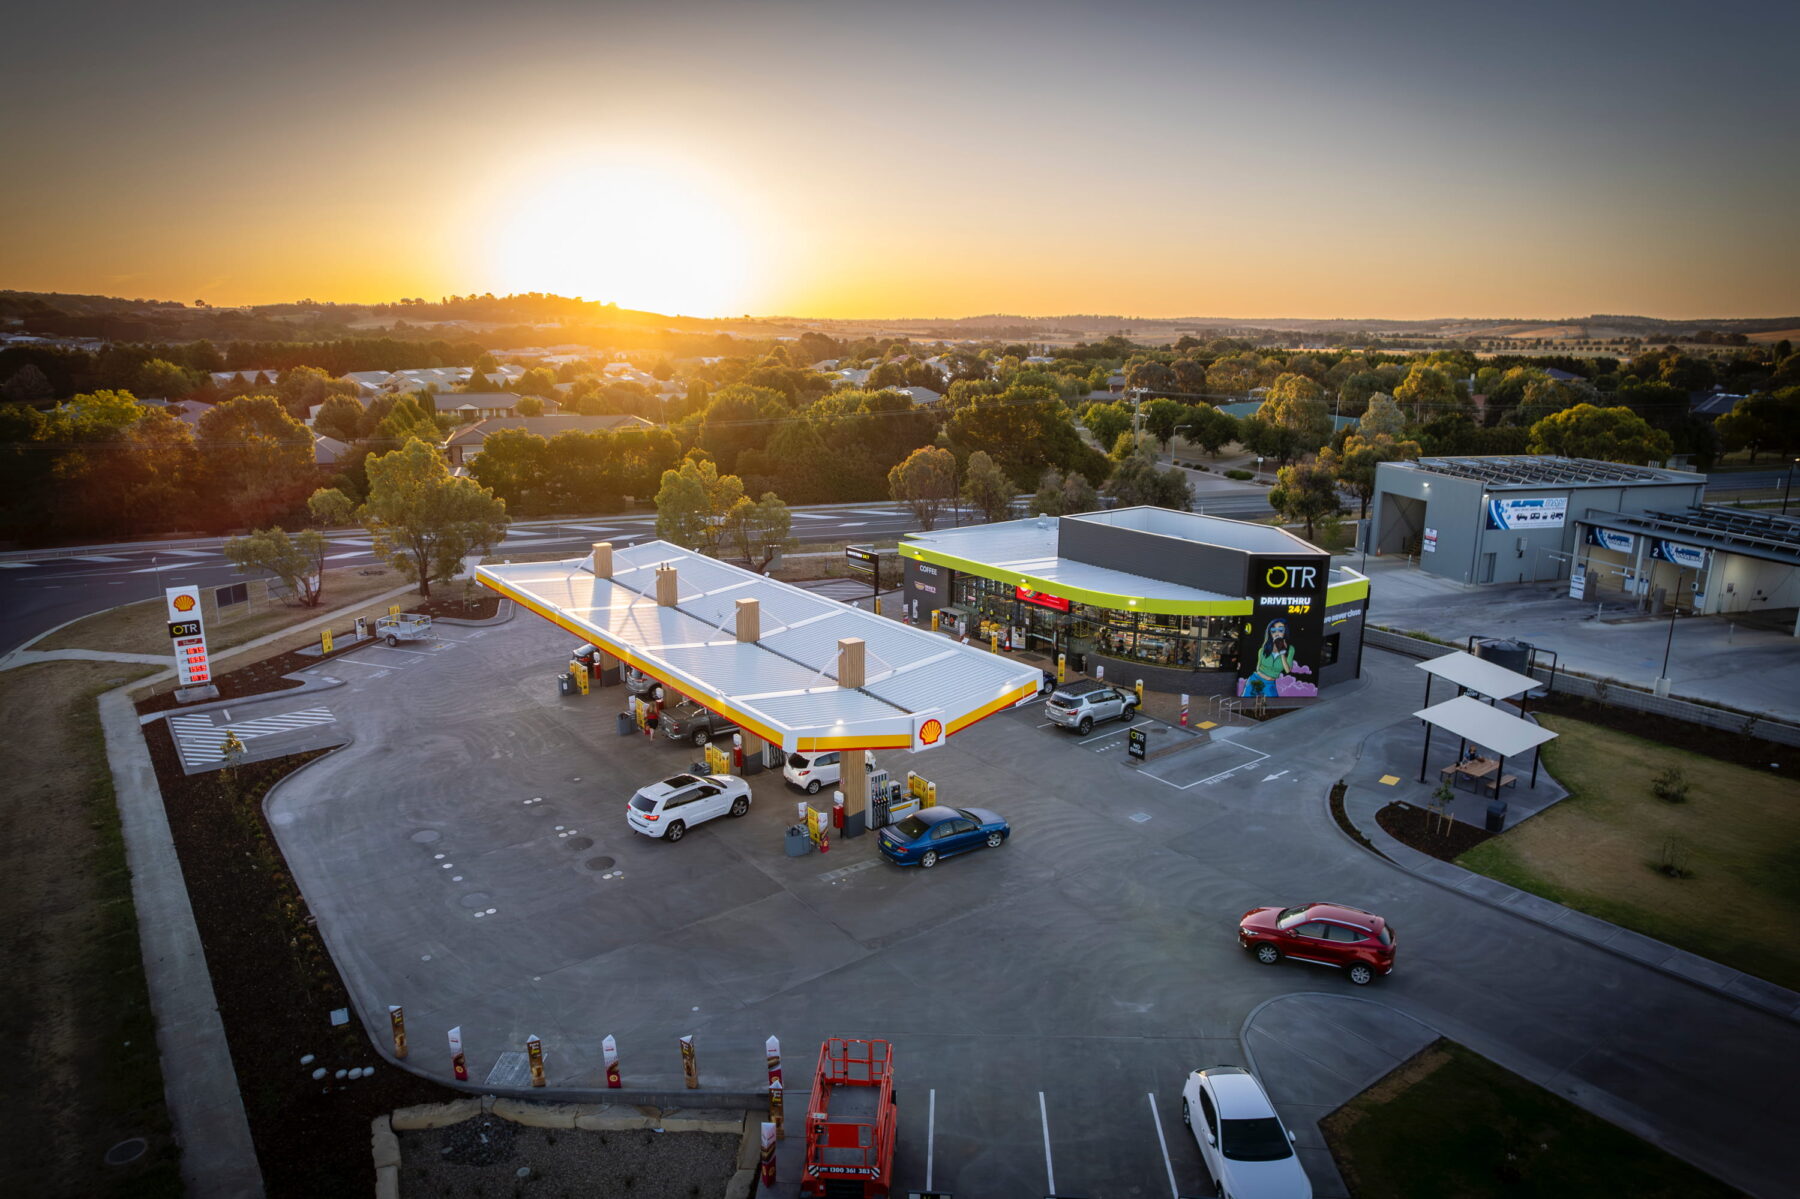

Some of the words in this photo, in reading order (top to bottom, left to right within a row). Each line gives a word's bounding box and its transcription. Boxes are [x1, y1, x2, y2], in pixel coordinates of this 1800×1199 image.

[1588, 534, 1593, 543] 1
[1653, 547, 1659, 557] 2
[920, 564, 938, 576] COFFEE
[1266, 566, 1316, 588] OTR
[1260, 596, 1311, 606] DRIVETHRU
[1288, 605, 1310, 614] 24/7
[173, 623, 197, 635] OTR
[1131, 731, 1144, 743] OTR
